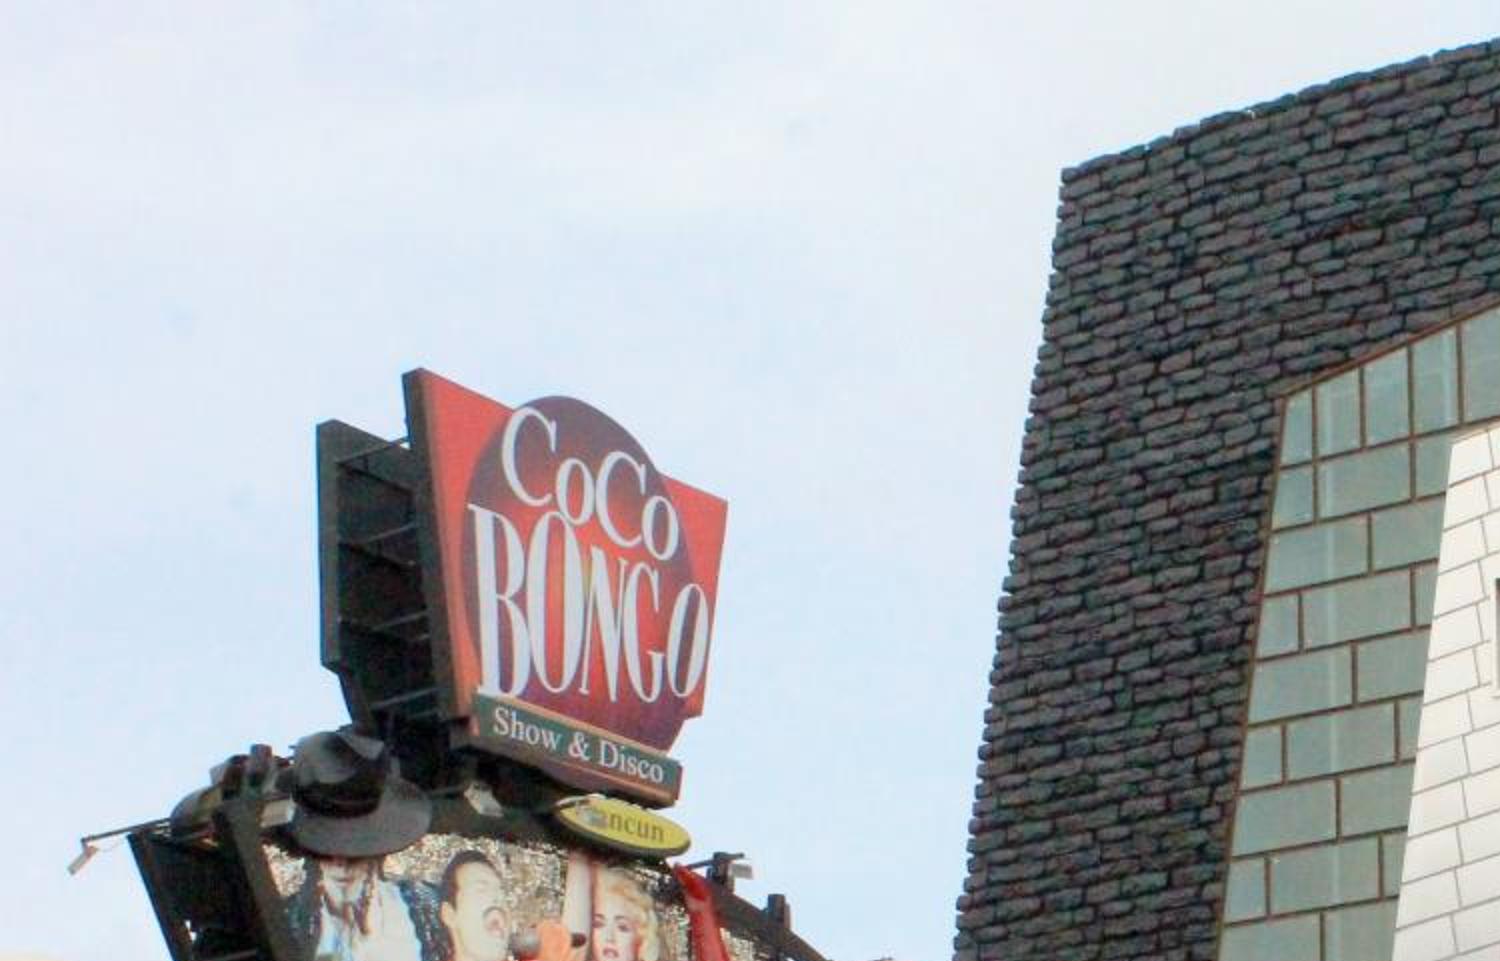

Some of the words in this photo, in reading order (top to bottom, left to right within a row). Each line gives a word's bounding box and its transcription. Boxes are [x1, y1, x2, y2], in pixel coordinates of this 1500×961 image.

[466, 503, 709, 704] BONGO
[493, 706, 560, 751] Show
[567, 731, 593, 762] &
[599, 739, 665, 784] Disco
